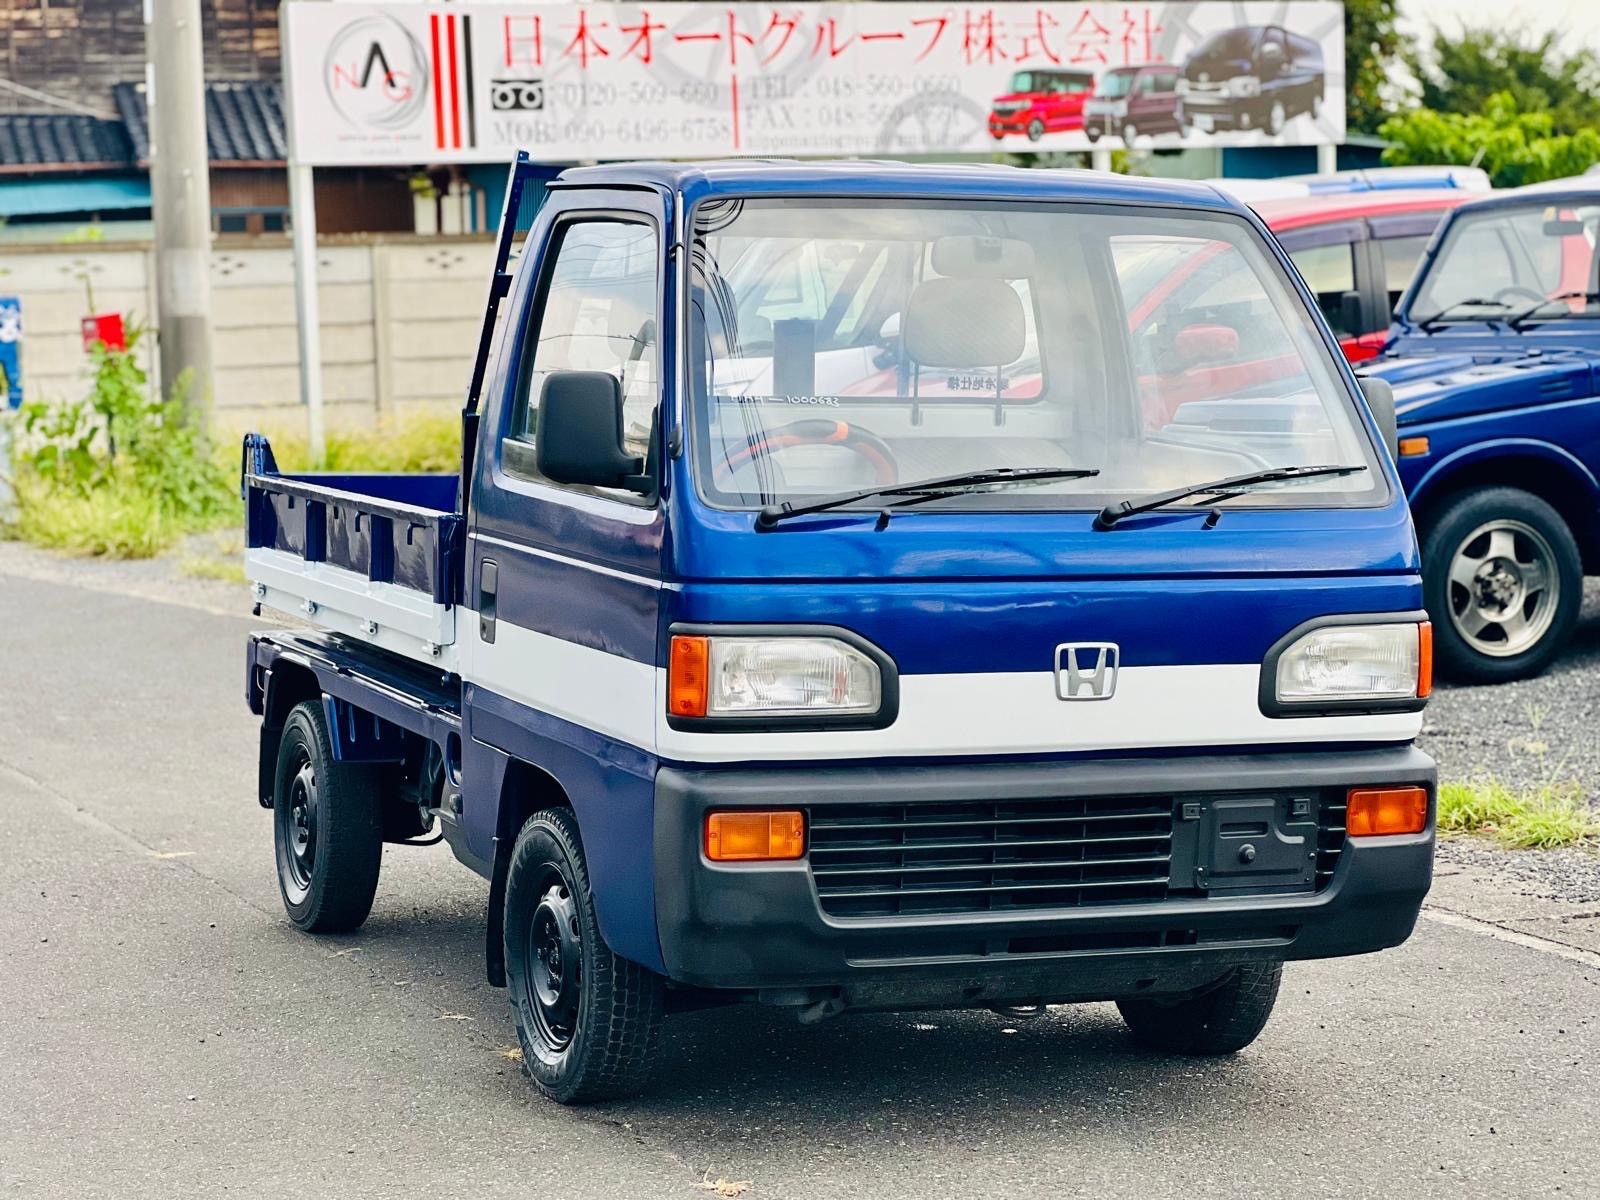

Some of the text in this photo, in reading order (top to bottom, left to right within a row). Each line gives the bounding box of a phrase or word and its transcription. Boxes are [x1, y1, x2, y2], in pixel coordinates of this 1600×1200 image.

[504, 9, 1165, 67] 日本オートグループ株式会社
[750, 76, 793, 99] TEL
[746, 104, 794, 127] FAX
